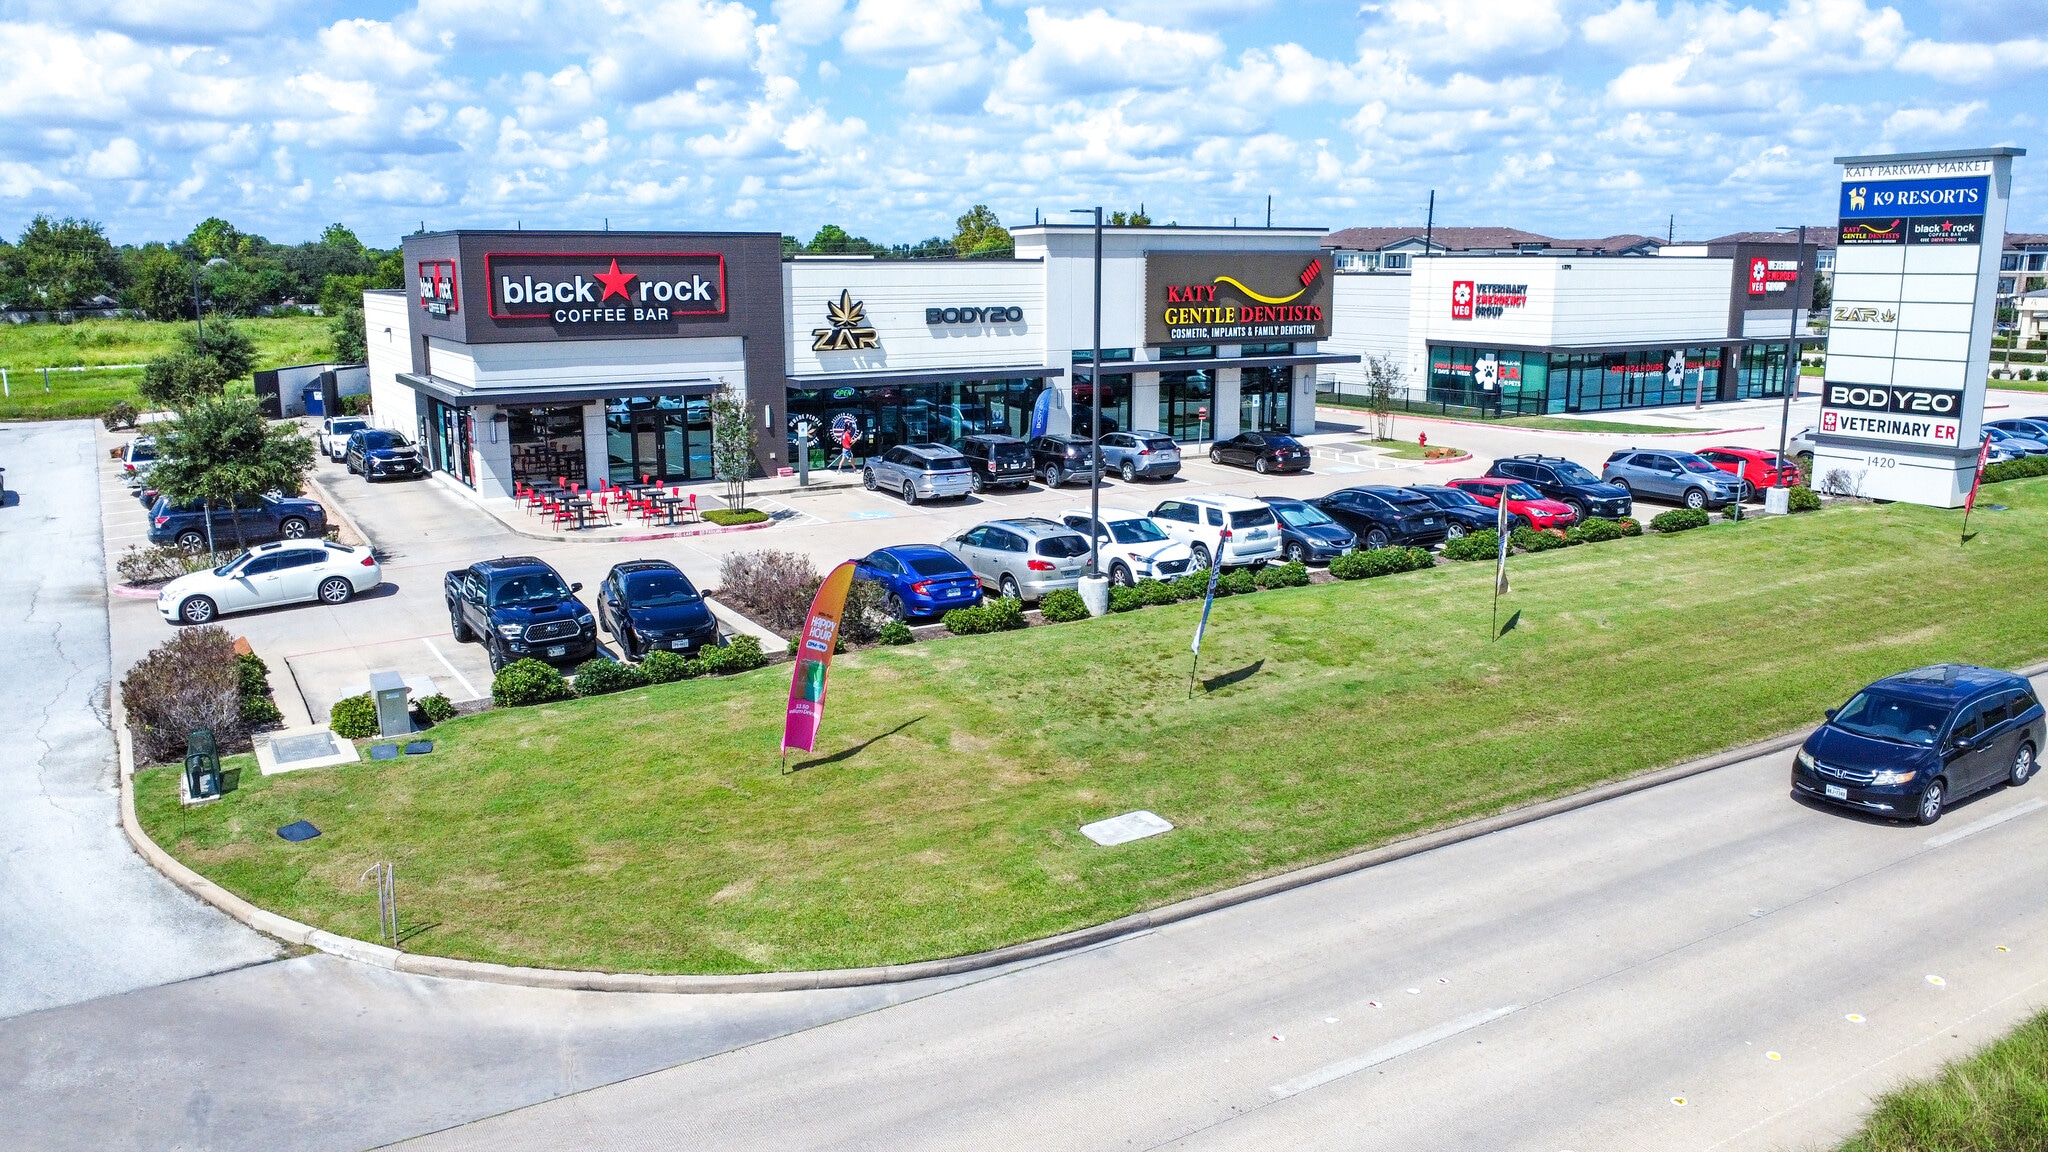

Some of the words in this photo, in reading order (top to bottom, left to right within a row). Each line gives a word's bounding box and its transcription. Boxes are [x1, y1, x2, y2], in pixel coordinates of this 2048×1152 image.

[1846, 167, 1875, 177] KATY
[1878, 163, 1933, 176] PARKWAY
[1937, 160, 1990, 173] MARKET
[1873, 191, 1895, 206] K9
[1897, 188, 1978, 205] RESORTS
[1914, 224, 1940, 233] black
[1952, 223, 1975, 232] rock
[420, 277, 435, 298] black
[439, 277, 453, 300] rock
[502, 275, 595, 303] black
[640, 275, 711, 302] rock
[1167, 285, 1217, 303] KATY
[1476, 283, 1528, 295] VETERINARY
[1751, 282, 1764, 292] VEG
[1475, 295, 1527, 307] EMERGENCY
[554, 309, 627, 323] COFFEE
[633, 307, 669, 322] BAR
[926, 306, 1024, 324] BODY20
[1165, 307, 1235, 325] GENTLE
[1240, 305, 1322, 323] DENTISTS
[1454, 305, 1470, 315] VEG
[1475, 306, 1504, 318] GROUP
[1834, 307, 1880, 323] ZAR
[812, 327, 880, 351] ZAR
[1171, 327, 1210, 339] COSMETIC,
[1211, 326, 1246, 338] IMPLANTS
[1247, 326, 1253, 336] &
[1254, 325, 1279, 336] FAMILY
[1280, 324, 1316, 336] DENTISTRY
[1498, 366, 1521, 379] E.R.
[1640, 363, 1664, 372] HOURS
[835, 389, 853, 397] OPEN
[1830, 386, 1953, 412] BODY20
[788, 414, 805, 428] WHERE
[806, 413, 823, 427] PEOPLE
[1840, 416, 1930, 437] VETERINARY
[1935, 425, 1955, 440] ER
[1867, 457, 1896, 468] 1420
[811, 616, 837, 631] HAPPY
[809, 626, 833, 641] HOUR
